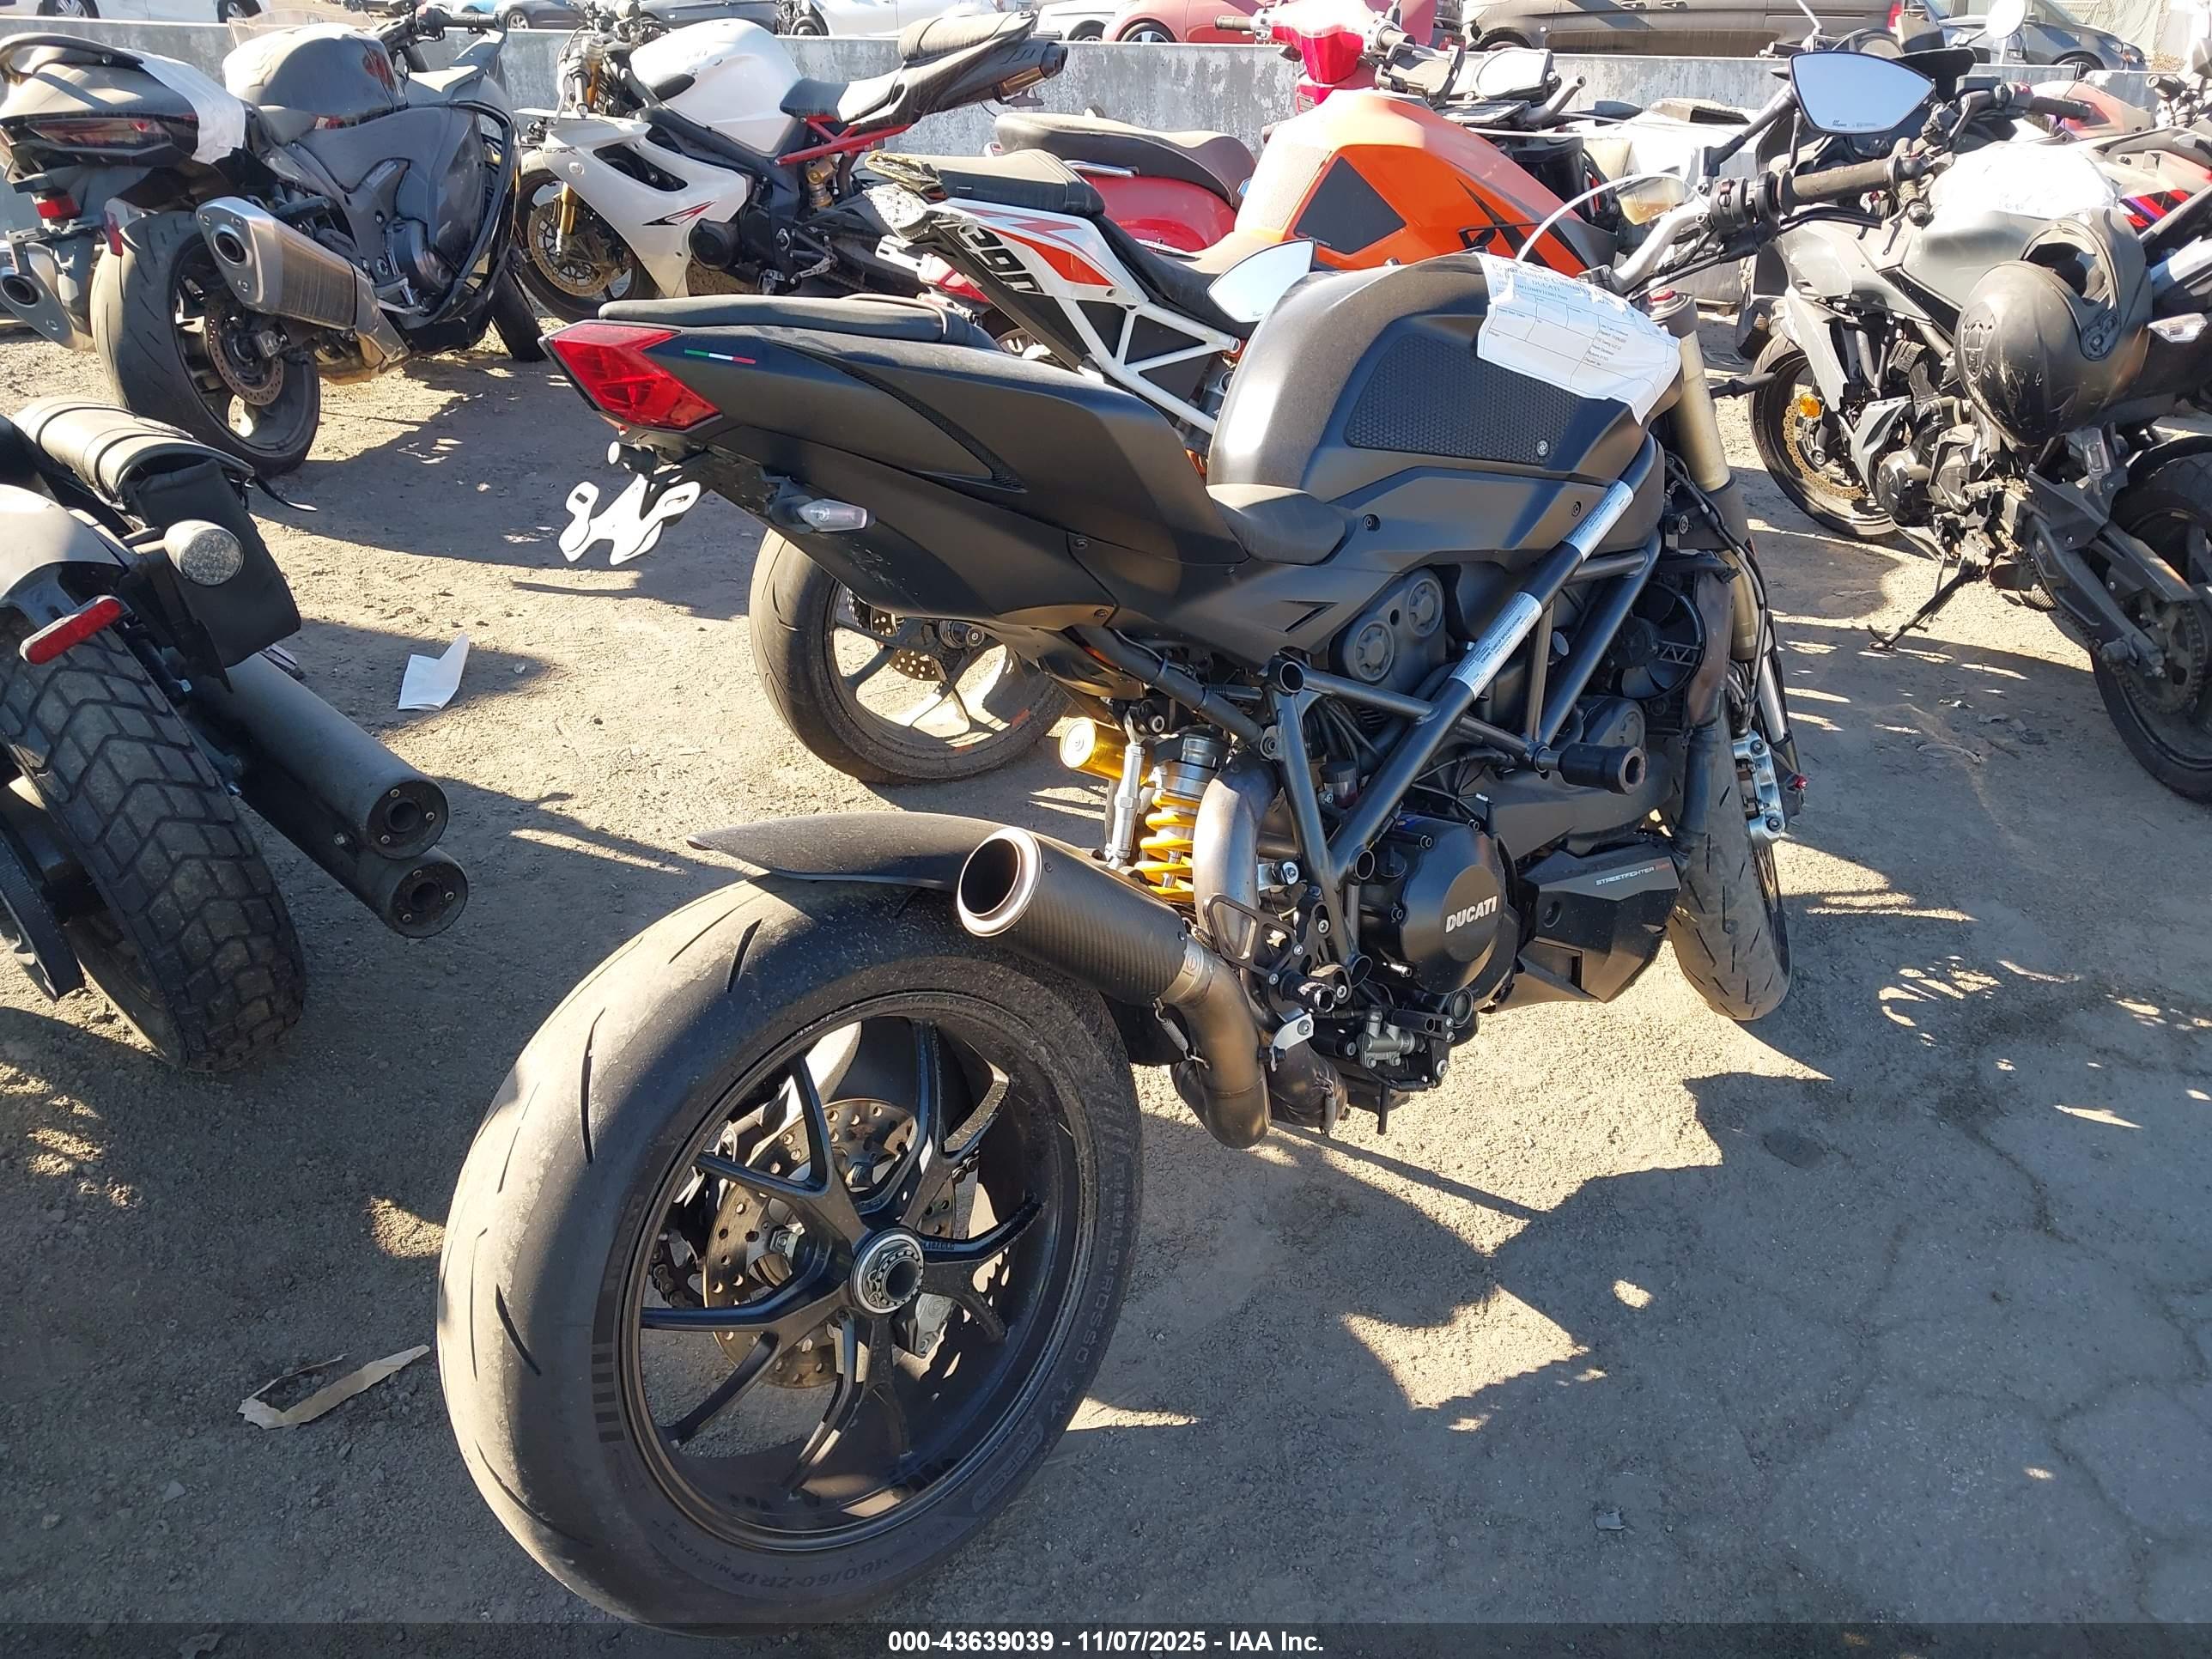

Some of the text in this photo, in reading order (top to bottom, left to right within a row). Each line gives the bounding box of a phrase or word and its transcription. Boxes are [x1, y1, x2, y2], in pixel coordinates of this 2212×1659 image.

[1595, 866, 1655, 886] STREETFIGHTER
[1445, 895, 1498, 933] DUCATI
[1073, 1273, 1115, 1364] ROSSO
